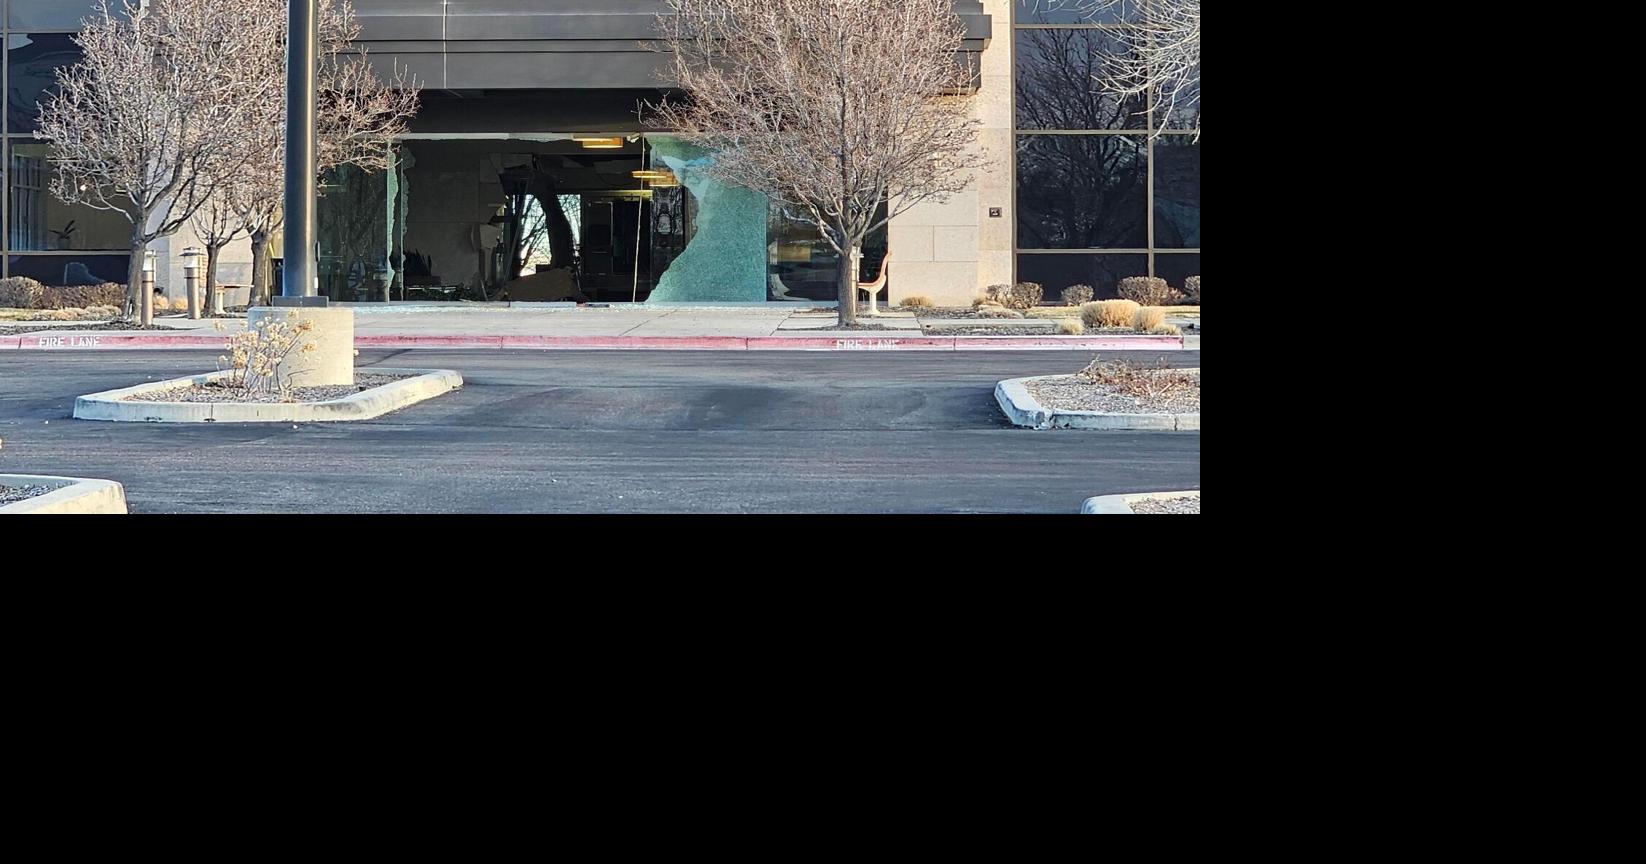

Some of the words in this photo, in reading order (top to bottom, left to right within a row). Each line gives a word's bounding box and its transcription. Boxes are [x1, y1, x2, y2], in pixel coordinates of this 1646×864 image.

[39, 337, 66, 347] FIRE
[71, 336, 101, 347] LANE
[836, 339, 864, 349] FIRE
[869, 339, 899, 349] LANE
